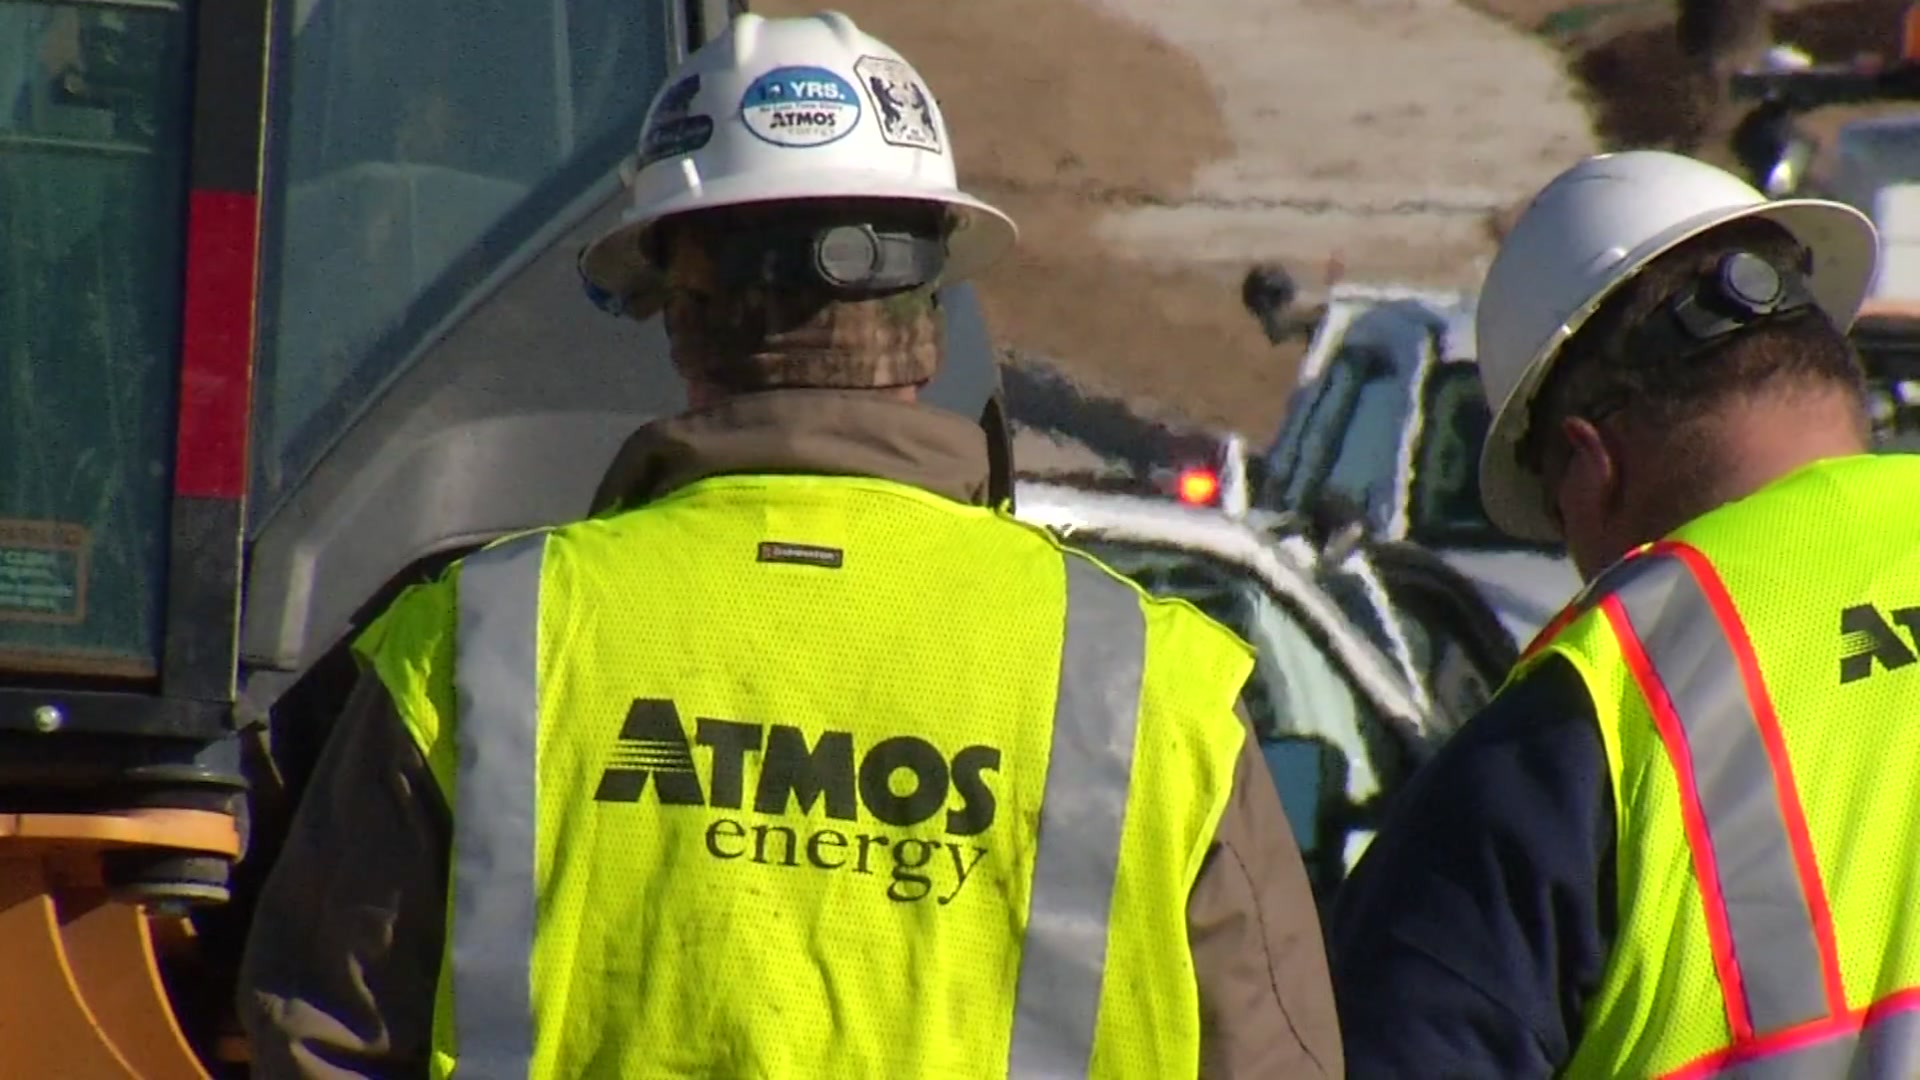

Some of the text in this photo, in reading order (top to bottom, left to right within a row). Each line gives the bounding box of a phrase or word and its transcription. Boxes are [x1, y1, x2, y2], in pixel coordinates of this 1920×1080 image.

[790, 81, 846, 100] YRS.
[769, 112, 836, 129] ATMOS
[593, 697, 1001, 837] ATMOS
[705, 817, 989, 905] energy
